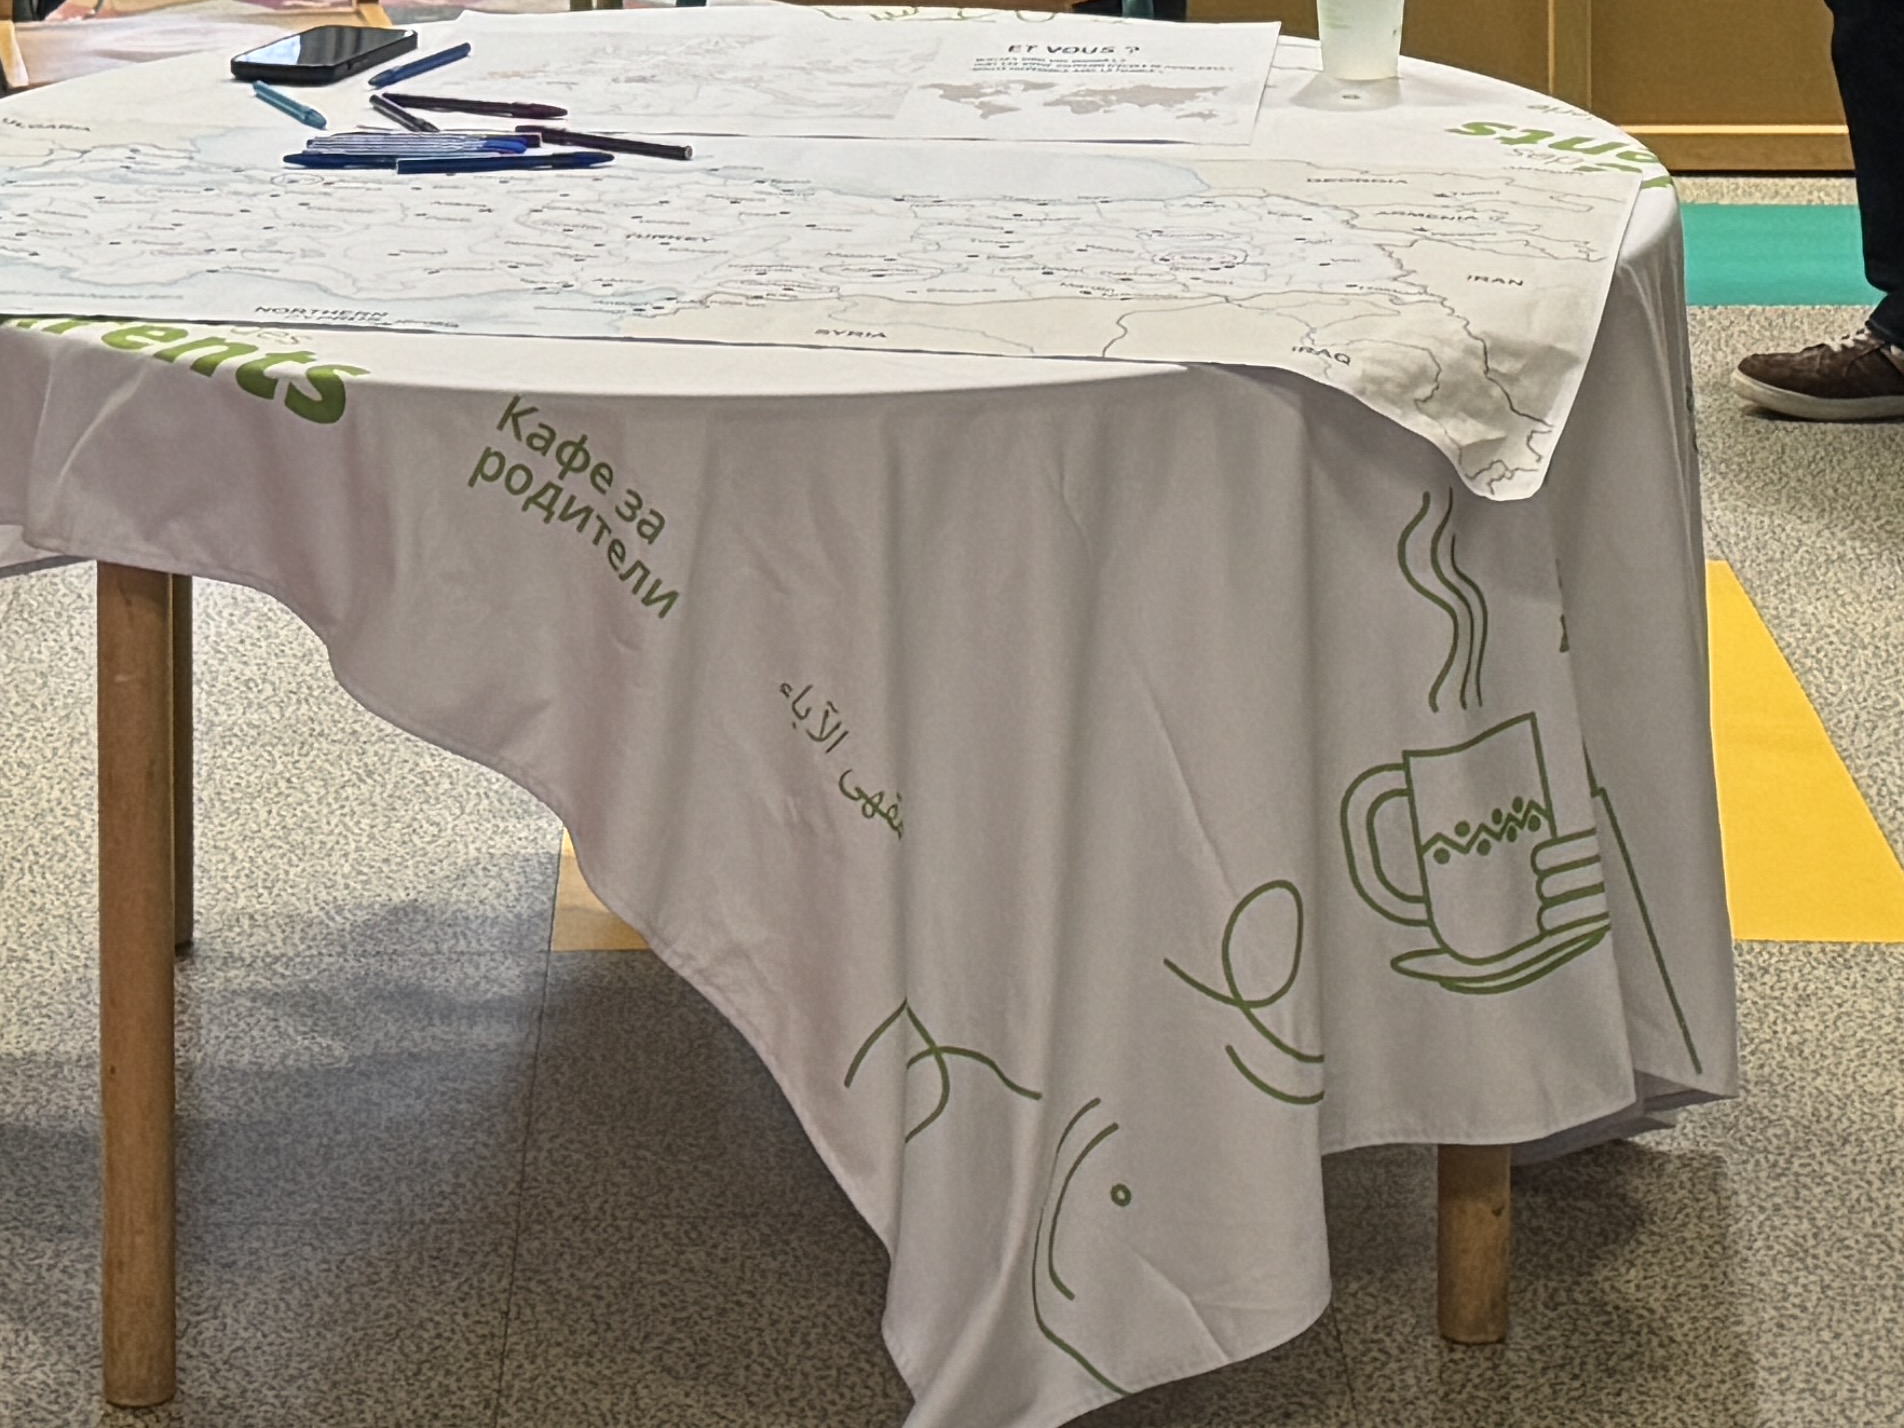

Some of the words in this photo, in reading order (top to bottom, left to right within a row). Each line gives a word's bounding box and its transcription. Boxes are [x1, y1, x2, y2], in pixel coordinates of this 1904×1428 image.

[1466, 274, 1525, 287] IRAN
[814, 327, 888, 340] SYRIA
[1291, 345, 1353, 367] IRAQ
[496, 394, 614, 496] Кафе
[614, 488, 666, 545] за
[467, 445, 681, 620] родители
